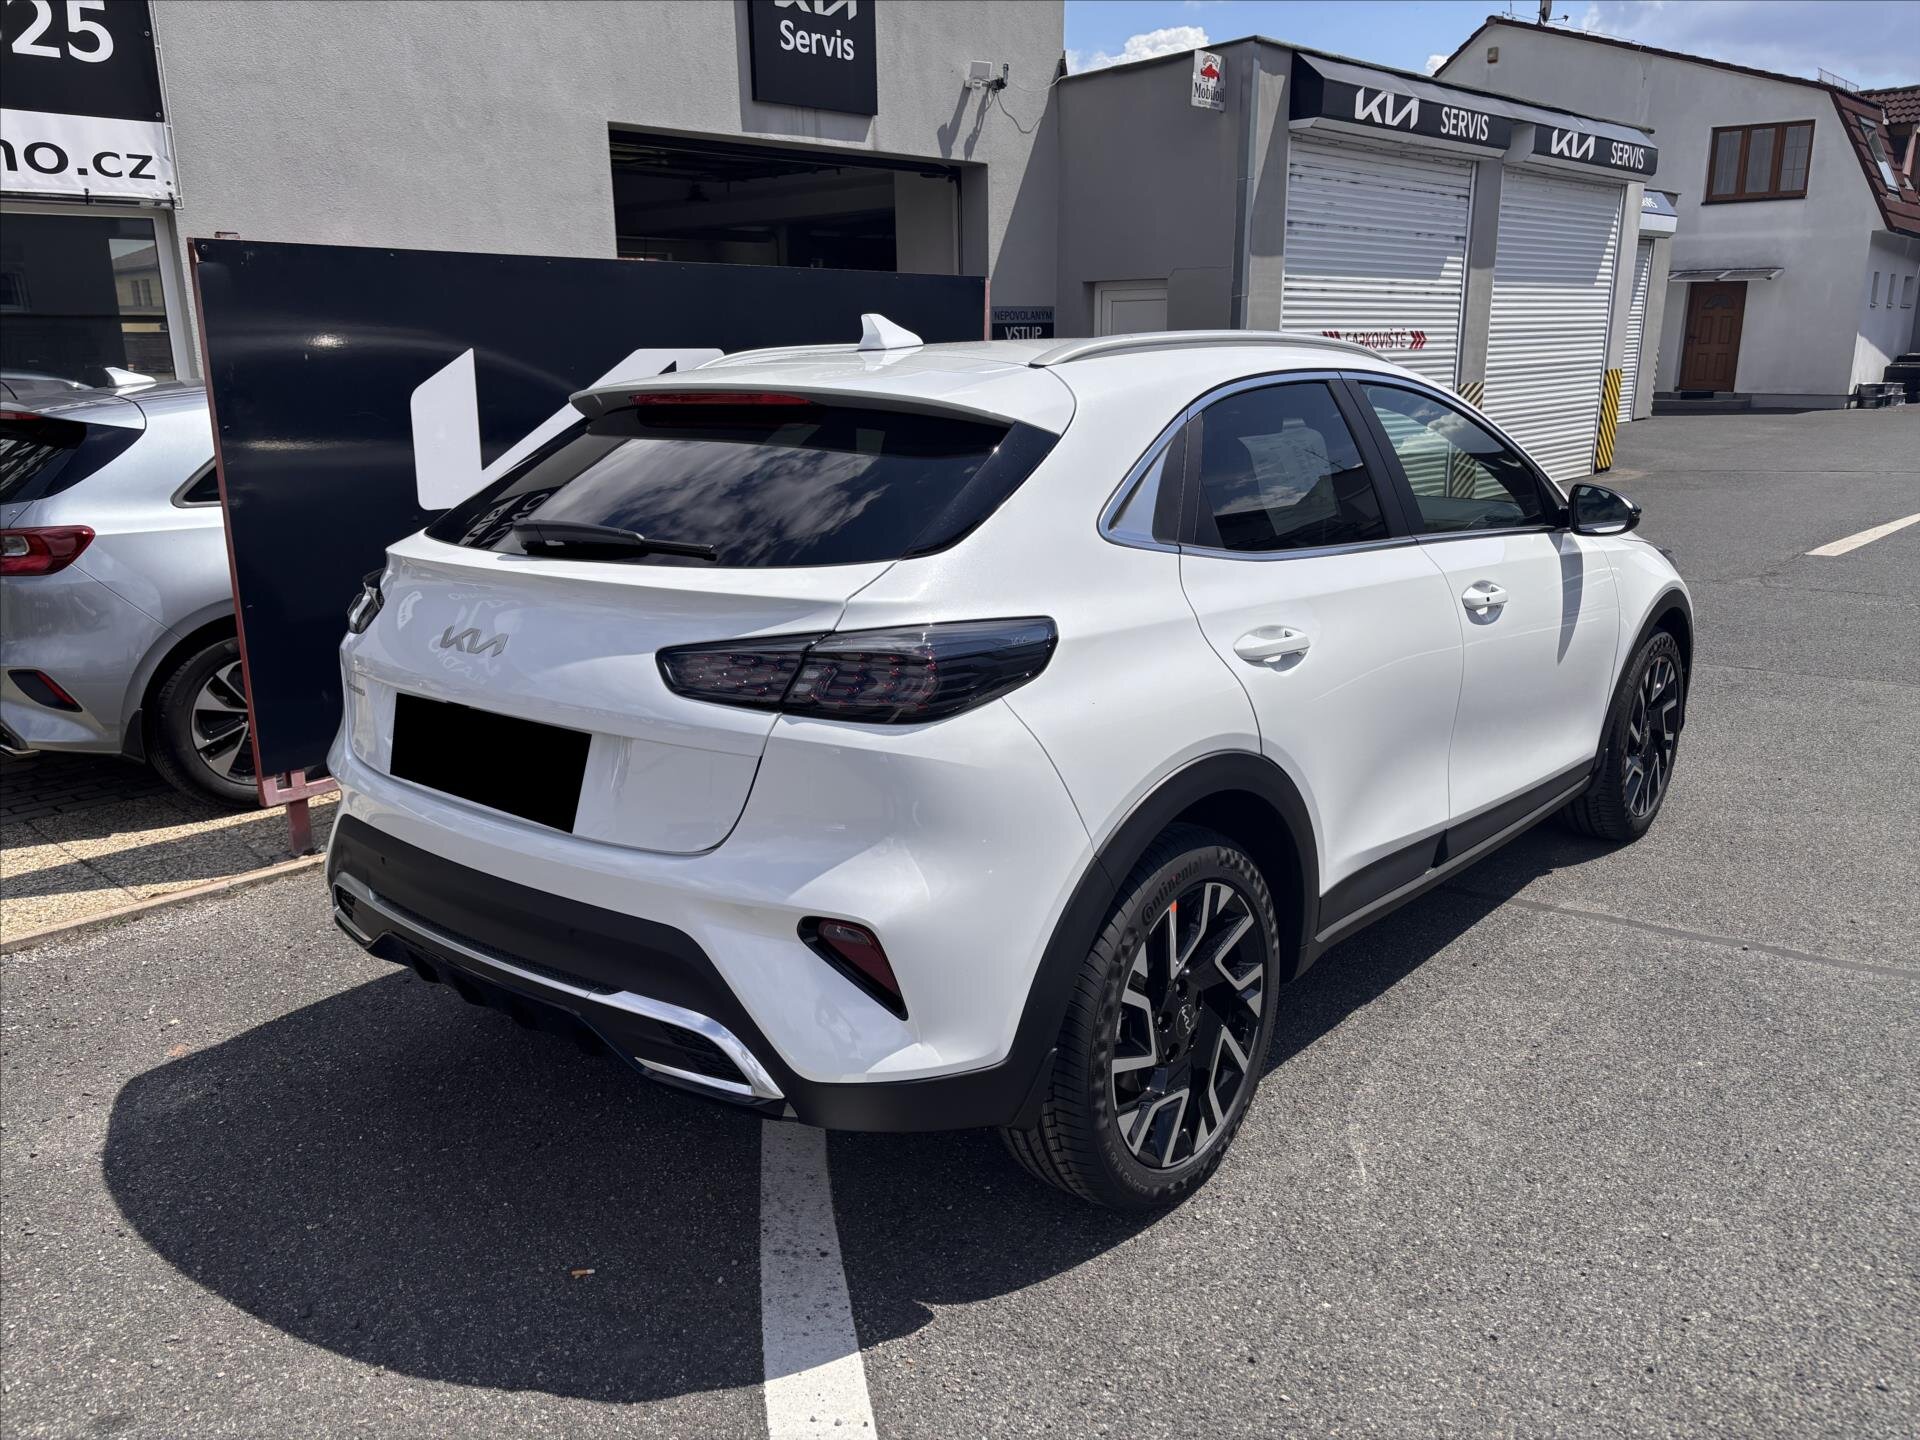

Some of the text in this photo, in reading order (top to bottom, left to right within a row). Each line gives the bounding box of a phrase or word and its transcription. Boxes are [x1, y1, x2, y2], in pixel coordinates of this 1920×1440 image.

[779, 19, 855, 61] Servis
[1354, 87, 1489, 142] KIA SERVIS
[1550, 127, 1646, 170] KIA SERVIS
[1004, 326, 1042, 340] VSTUP
[439, 624, 510, 658] KIA
